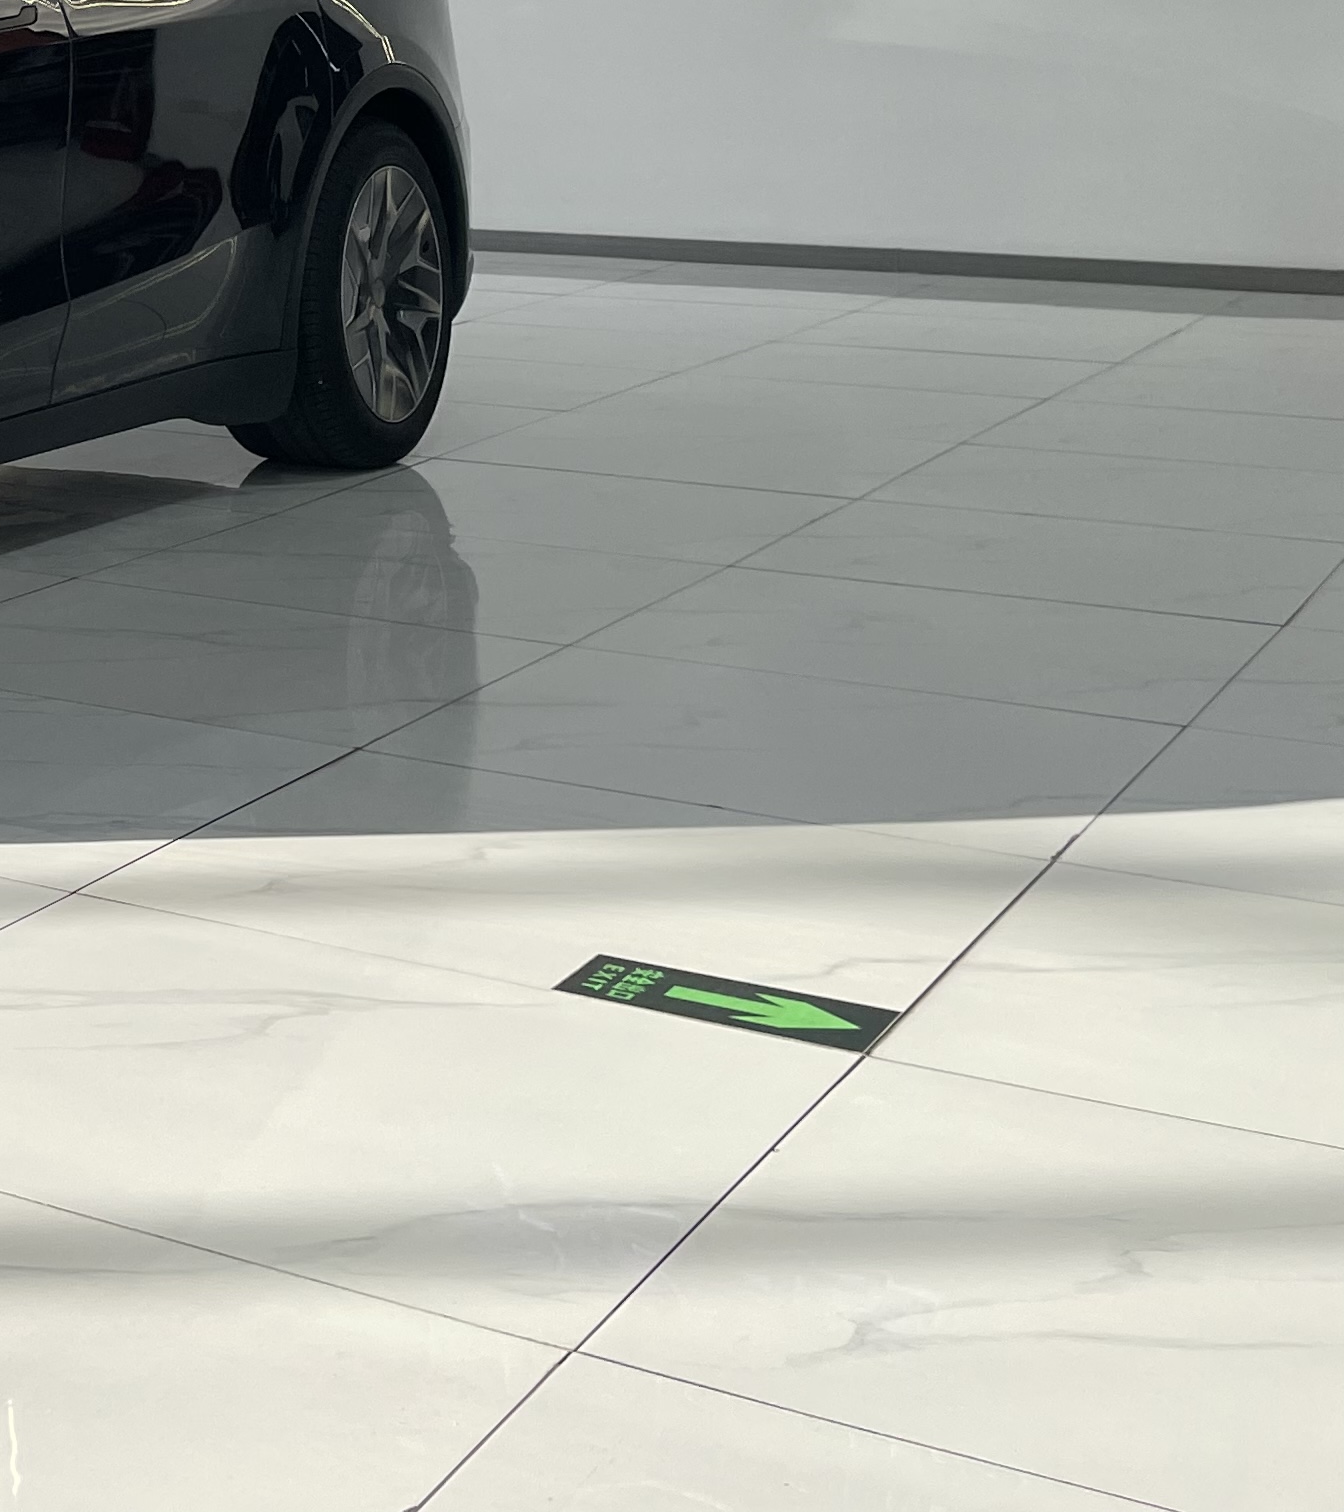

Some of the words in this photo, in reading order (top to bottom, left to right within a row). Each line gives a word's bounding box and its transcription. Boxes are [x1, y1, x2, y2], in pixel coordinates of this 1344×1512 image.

[581, 963, 625, 990] EXIT
[606, 967, 664, 1000] 安全出口
